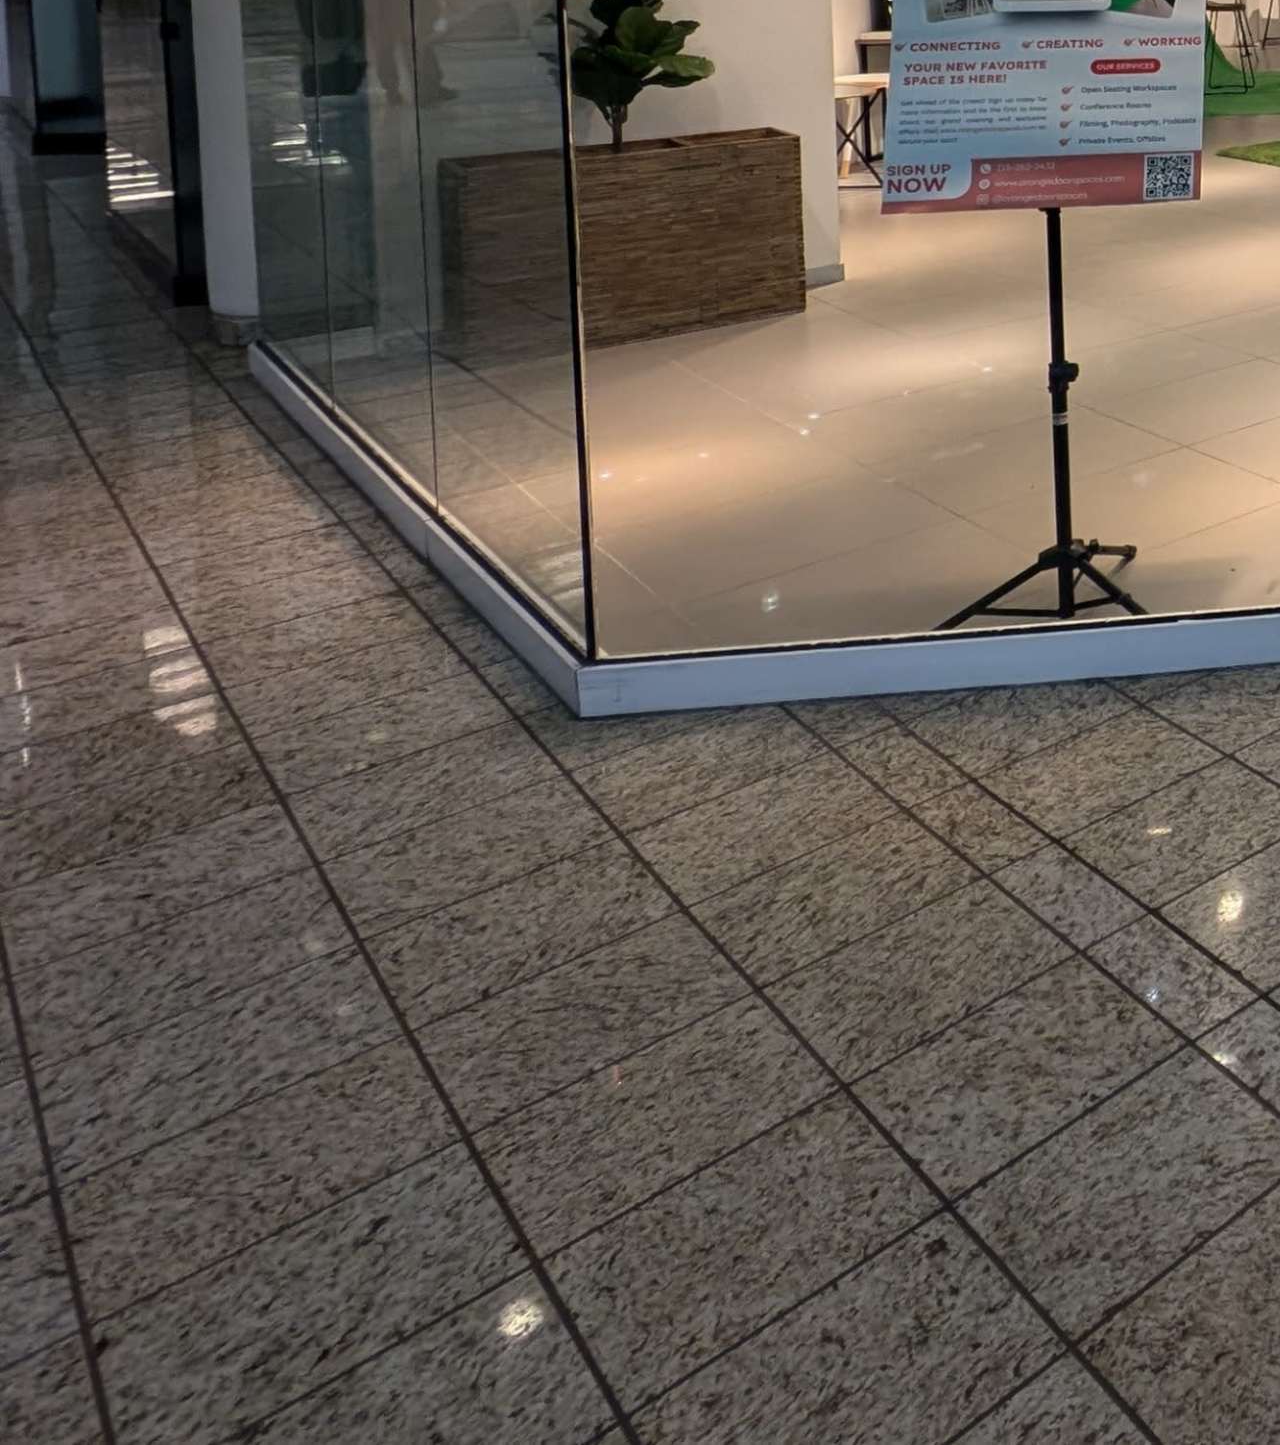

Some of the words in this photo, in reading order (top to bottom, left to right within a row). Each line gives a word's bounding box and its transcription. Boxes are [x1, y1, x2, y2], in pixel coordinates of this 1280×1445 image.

[910, 41, 1001, 52] CONNECTING
[1036, 38, 1104, 49] CREATING
[1138, 36, 1201, 47] WORKING
[904, 62, 941, 72] YOUR
[945, 62, 977, 71] NEW
[981, 60, 1047, 70] FAVORITE
[1116, 61, 1155, 70] SERVICES
[903, 75, 945, 86] SPACE
[950, 75, 965, 85] IS
[968, 73, 1007, 84] HERE!
[886, 164, 928, 177] SIGN
[930, 163, 951, 175] UP
[886, 176, 947, 195] NOW
